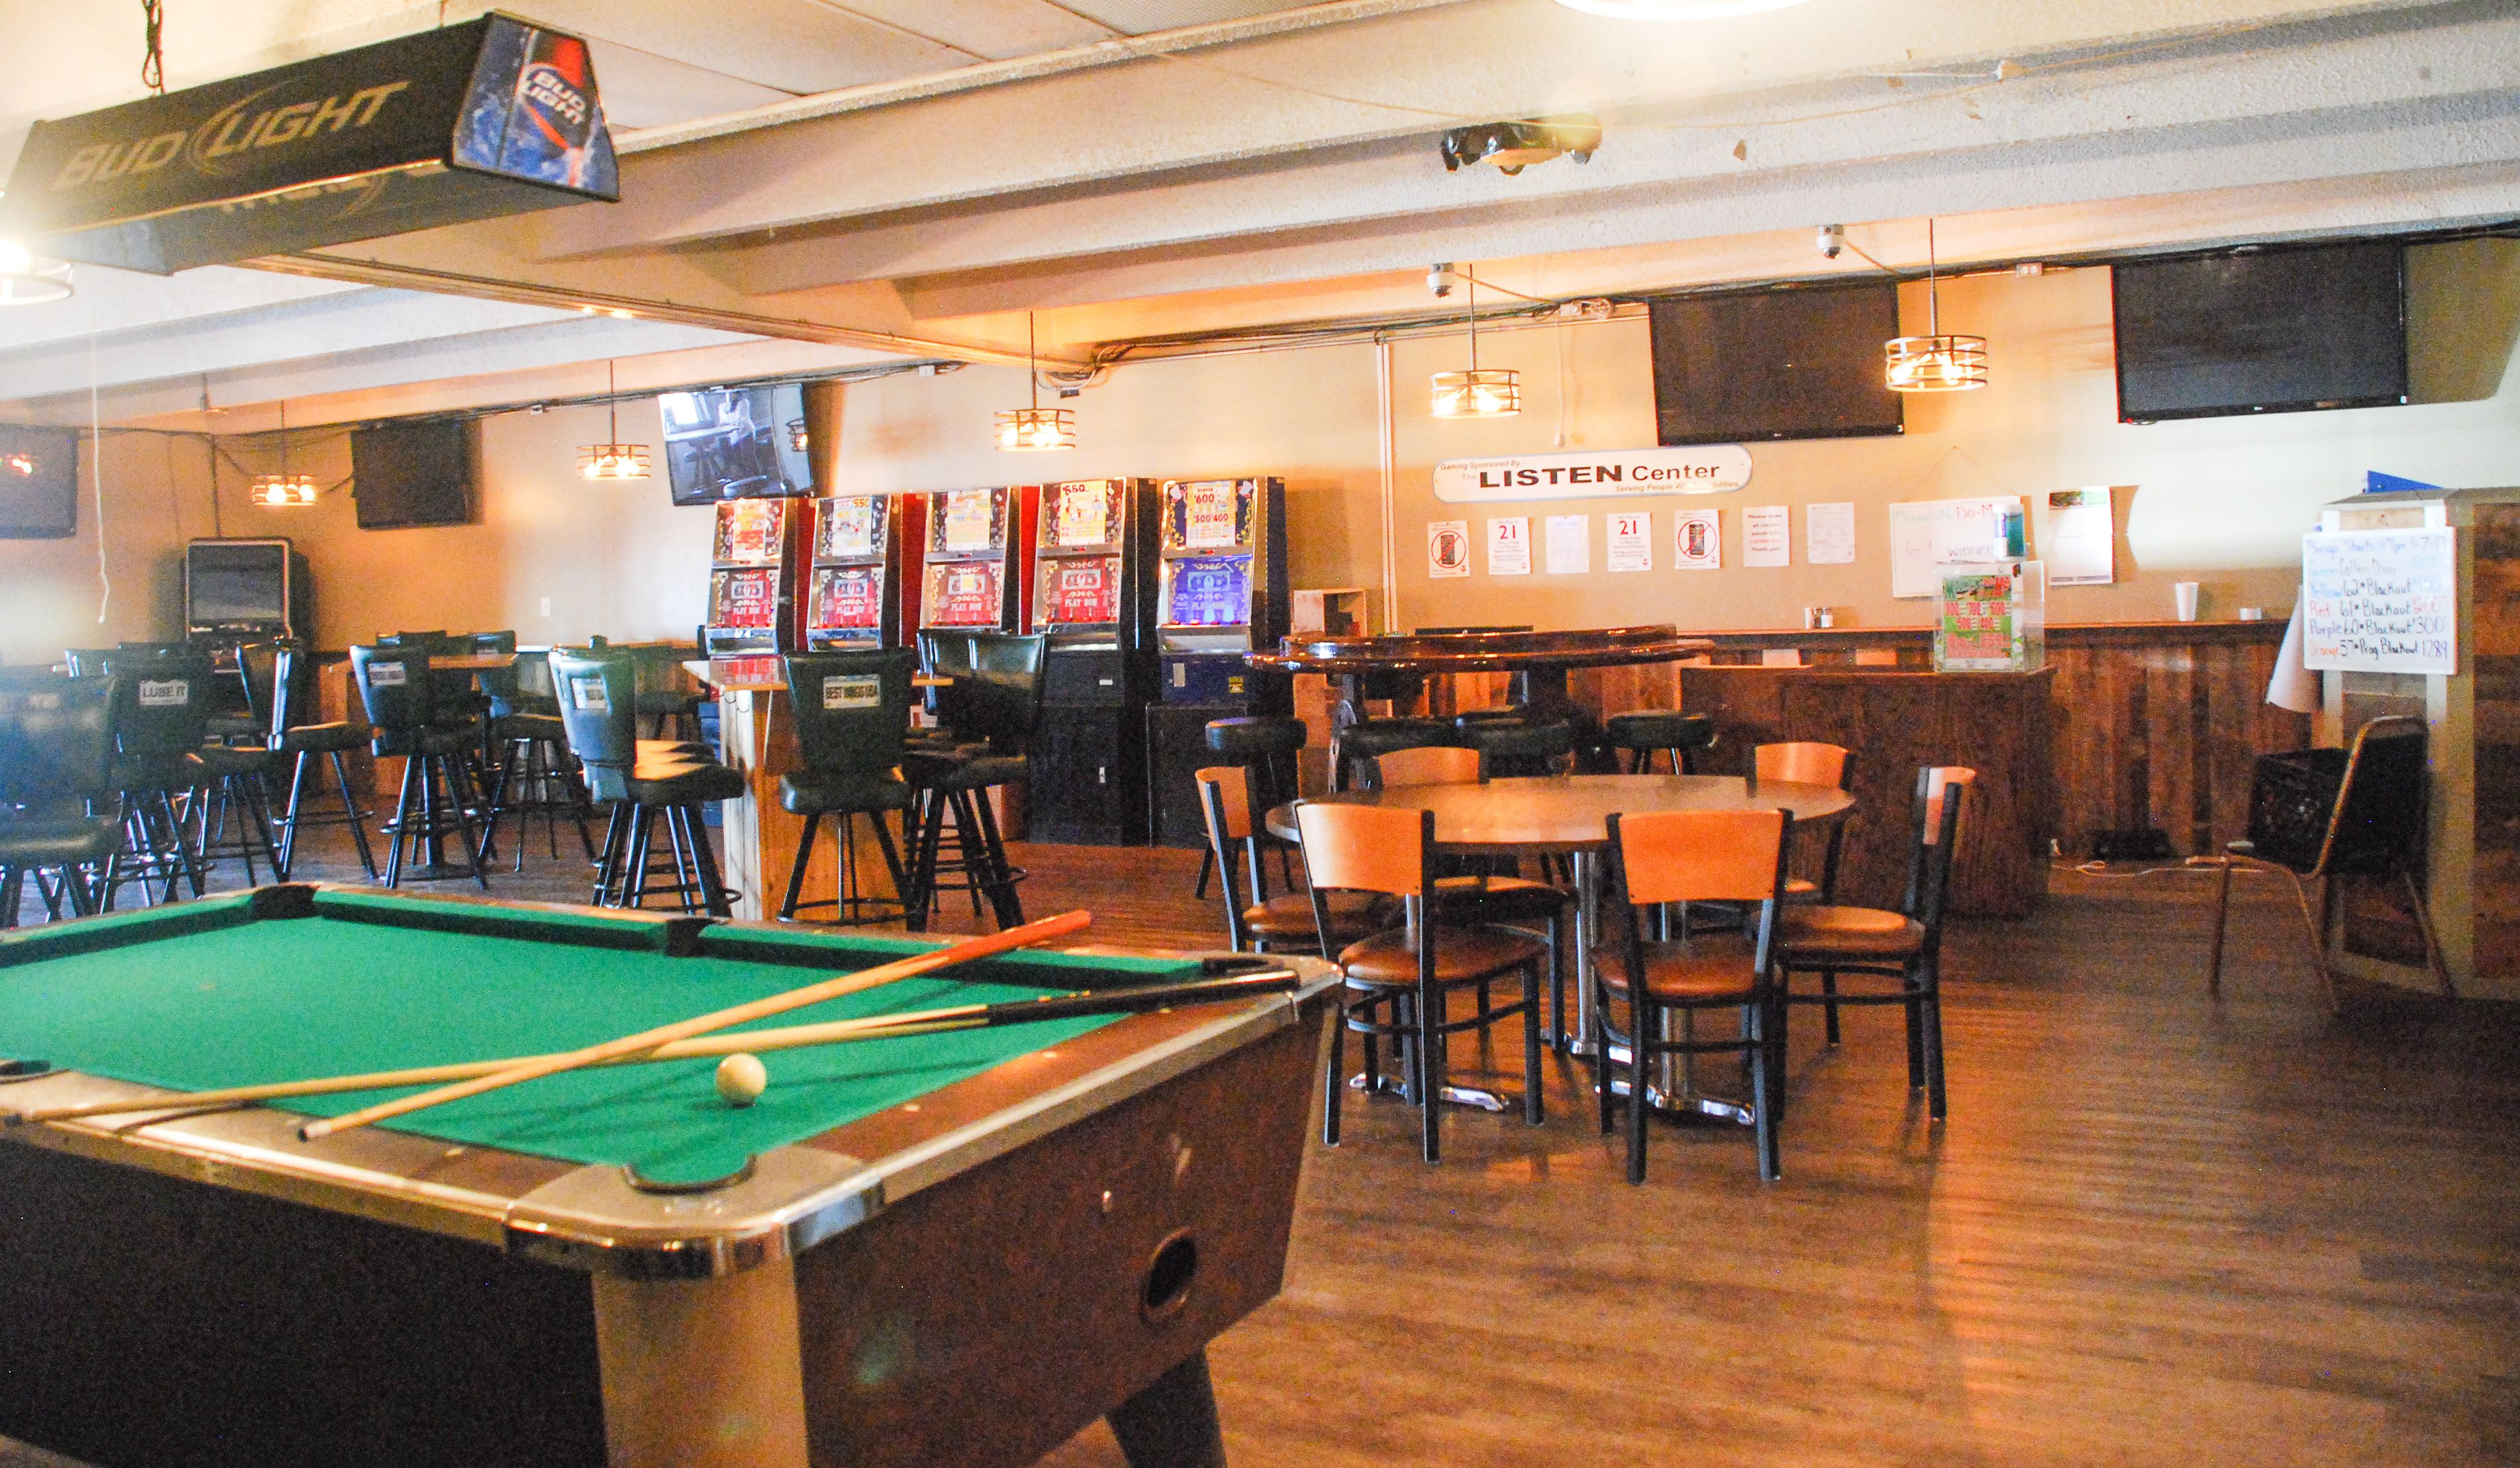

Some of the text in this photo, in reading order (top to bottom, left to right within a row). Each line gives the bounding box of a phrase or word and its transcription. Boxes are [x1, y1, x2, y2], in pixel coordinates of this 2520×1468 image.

[533, 71, 585, 111] BUD
[522, 81, 583, 124] LIGHT
[52, 81, 411, 191] BUD LIGHT
[1470, 461, 1509, 469] Sponsored
[1480, 465, 1622, 488] LISTEN
[1632, 465, 1720, 481] Center
[1647, 483, 1674, 492] People
[1499, 525, 1517, 540] 21
[1619, 520, 1637, 535] 21
[2309, 618, 2342, 639] Purple
